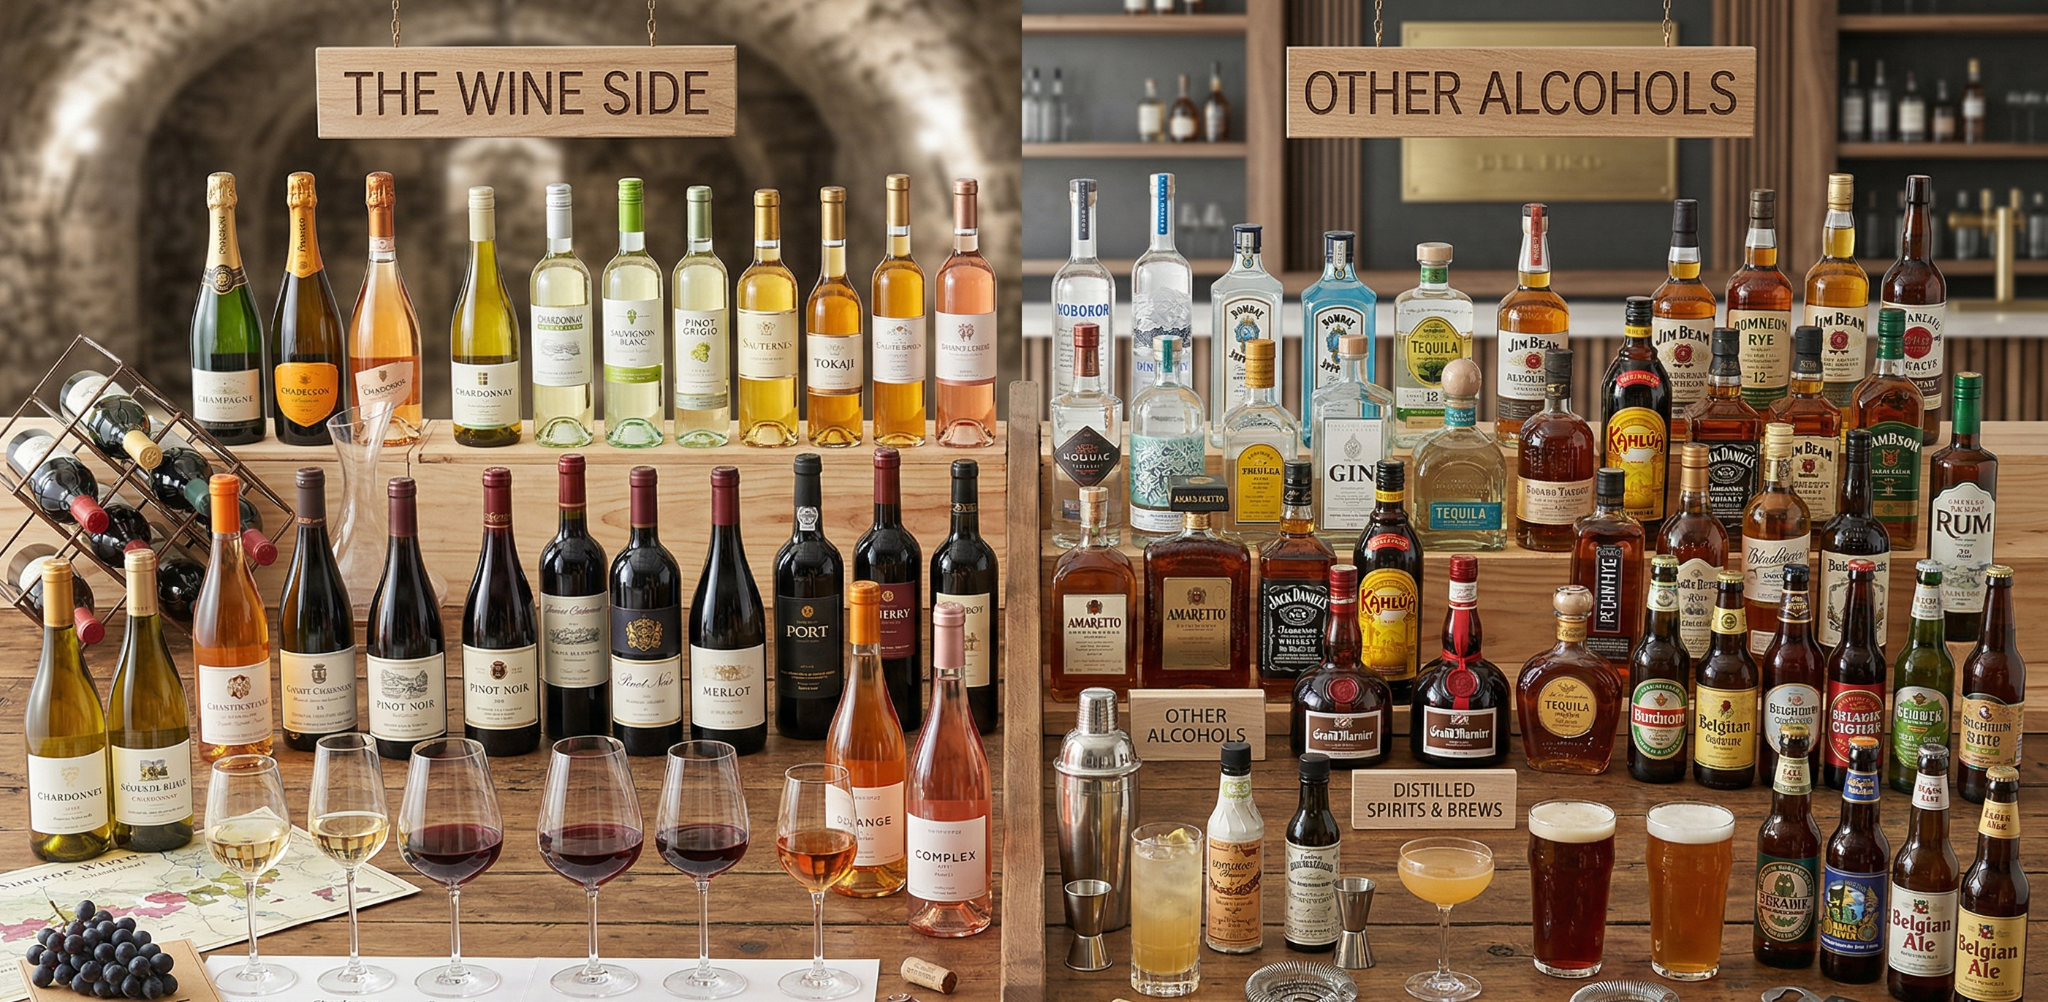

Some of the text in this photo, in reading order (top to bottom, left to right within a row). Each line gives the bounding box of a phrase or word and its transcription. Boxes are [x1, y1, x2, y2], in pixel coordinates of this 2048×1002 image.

[343, 70, 710, 116] THE WINE SIDE
[1304, 70, 1738, 116] OTHER ALCOHOLS
[685, 318, 716, 328] PINOT
[1835, 312, 1865, 332] BEAM
[610, 328, 655, 338] SAUVIGNON
[683, 327, 718, 336] GRIGIO
[1655, 325, 1710, 346] JIM BEAM
[619, 337, 648, 346] BLANC
[1411, 340, 1459, 354] TEQUILA
[1508, 336, 1559, 353] JIM BEAM
[1748, 333, 1774, 346] RYE
[814, 358, 855, 371] TOKAJI
[1753, 371, 1766, 384] 12
[197, 392, 254, 404] CHAMPAGNE
[455, 387, 514, 398] CHARDONNAY
[1608, 425, 1665, 455] KAHLÚA
[1804, 441, 1833, 462] BEAM
[1328, 464, 1375, 483] GIN
[1435, 507, 1487, 520] TEQUILA
[1936, 509, 1992, 540] RUM
[1268, 587, 1330, 611] JACK DANIEL'S
[1360, 588, 1417, 614] KAHLÚA
[878, 607, 911, 620] ERRY
[1166, 607, 1227, 622] AMARETTO
[1067, 617, 1122, 629] AMARETTO
[786, 624, 829, 638] PORT
[617, 671, 674, 690] Pinot Noir
[470, 682, 530, 695] PINOT NOIR
[702, 685, 751, 697] MERLOT
[376, 699, 435, 711] PINOT NOIR
[1544, 700, 1590, 713] TEQUILA
[1165, 708, 1227, 724] OTHER
[1147, 727, 1247, 744] ALCOHOLS
[1393, 782, 1475, 798] DISTILLED
[1367, 802, 1503, 818] SPIRITS & BREWS
[915, 849, 977, 864] COMPLEX
[1892, 908, 1951, 935] Belgian
[1902, 932, 1936, 952] Ale
[1958, 933, 2018, 962] Belgian
[1967, 958, 2001, 979] Ale
